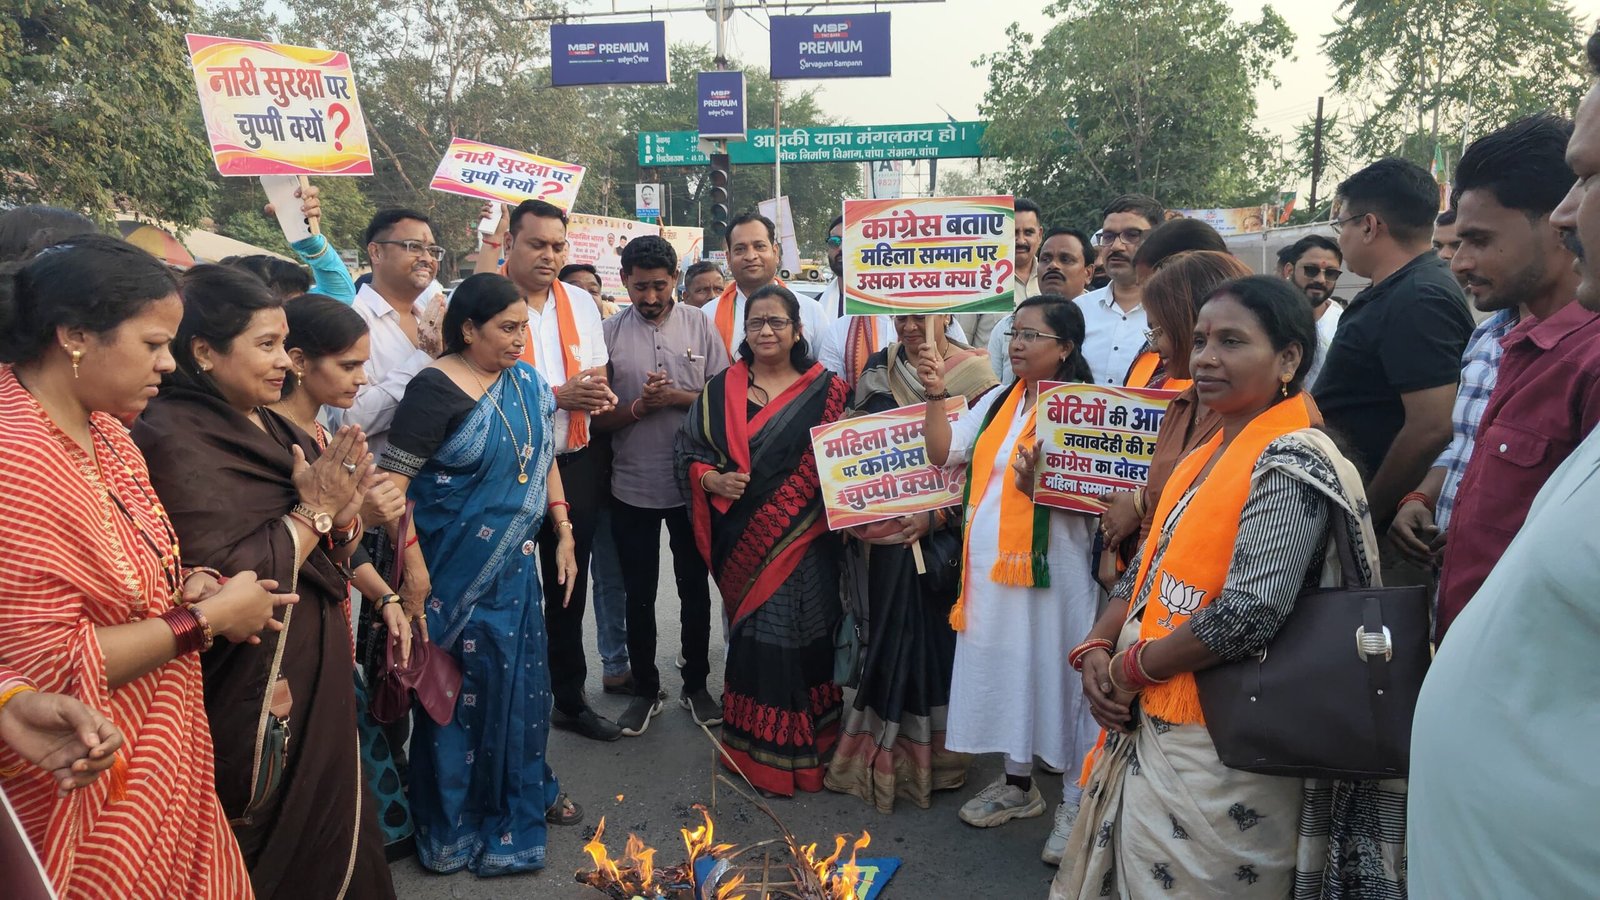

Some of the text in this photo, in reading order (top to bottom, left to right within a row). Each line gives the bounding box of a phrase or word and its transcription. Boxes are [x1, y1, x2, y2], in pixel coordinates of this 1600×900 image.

[813, 24, 848, 33] MSP
[568, 42, 649, 54] MSP PREMIUM
[799, 40, 863, 54] PREMIUM
[834, 60, 863, 68] Sampann
[206, 57, 351, 108] नारी सुरक्षा पर
[703, 99, 738, 107] PREMIUM
[234, 106, 286, 149] चुप्पी
[814, 132, 853, 146] यात्रा
[856, 127, 934, 144] मंगलमय
[800, 147, 830, 160] निर्माण
[454, 150, 574, 184] नारी सुरक्षा पर
[460, 168, 500, 185] चुप्पी
[861, 209, 1005, 239] कांग्रेस बताए
[860, 242, 998, 266] महिला सम्मान पर
[857, 272, 905, 290] उसका
[909, 271, 941, 288] रुख
[945, 270, 977, 288] क्या
[1047, 394, 1107, 426] बेटियों
[1109, 405, 1128, 427] की
[823, 428, 886, 459] महिला
[1064, 432, 1123, 454] जवाबदेही
[1126, 436, 1144, 456] की
[842, 446, 926, 477] पर कांग्रेस
[1046, 450, 1149, 481] कांग्रेस का दोहर
[843, 474, 899, 511] चुप्पी
[1045, 474, 1077, 493] महिला
